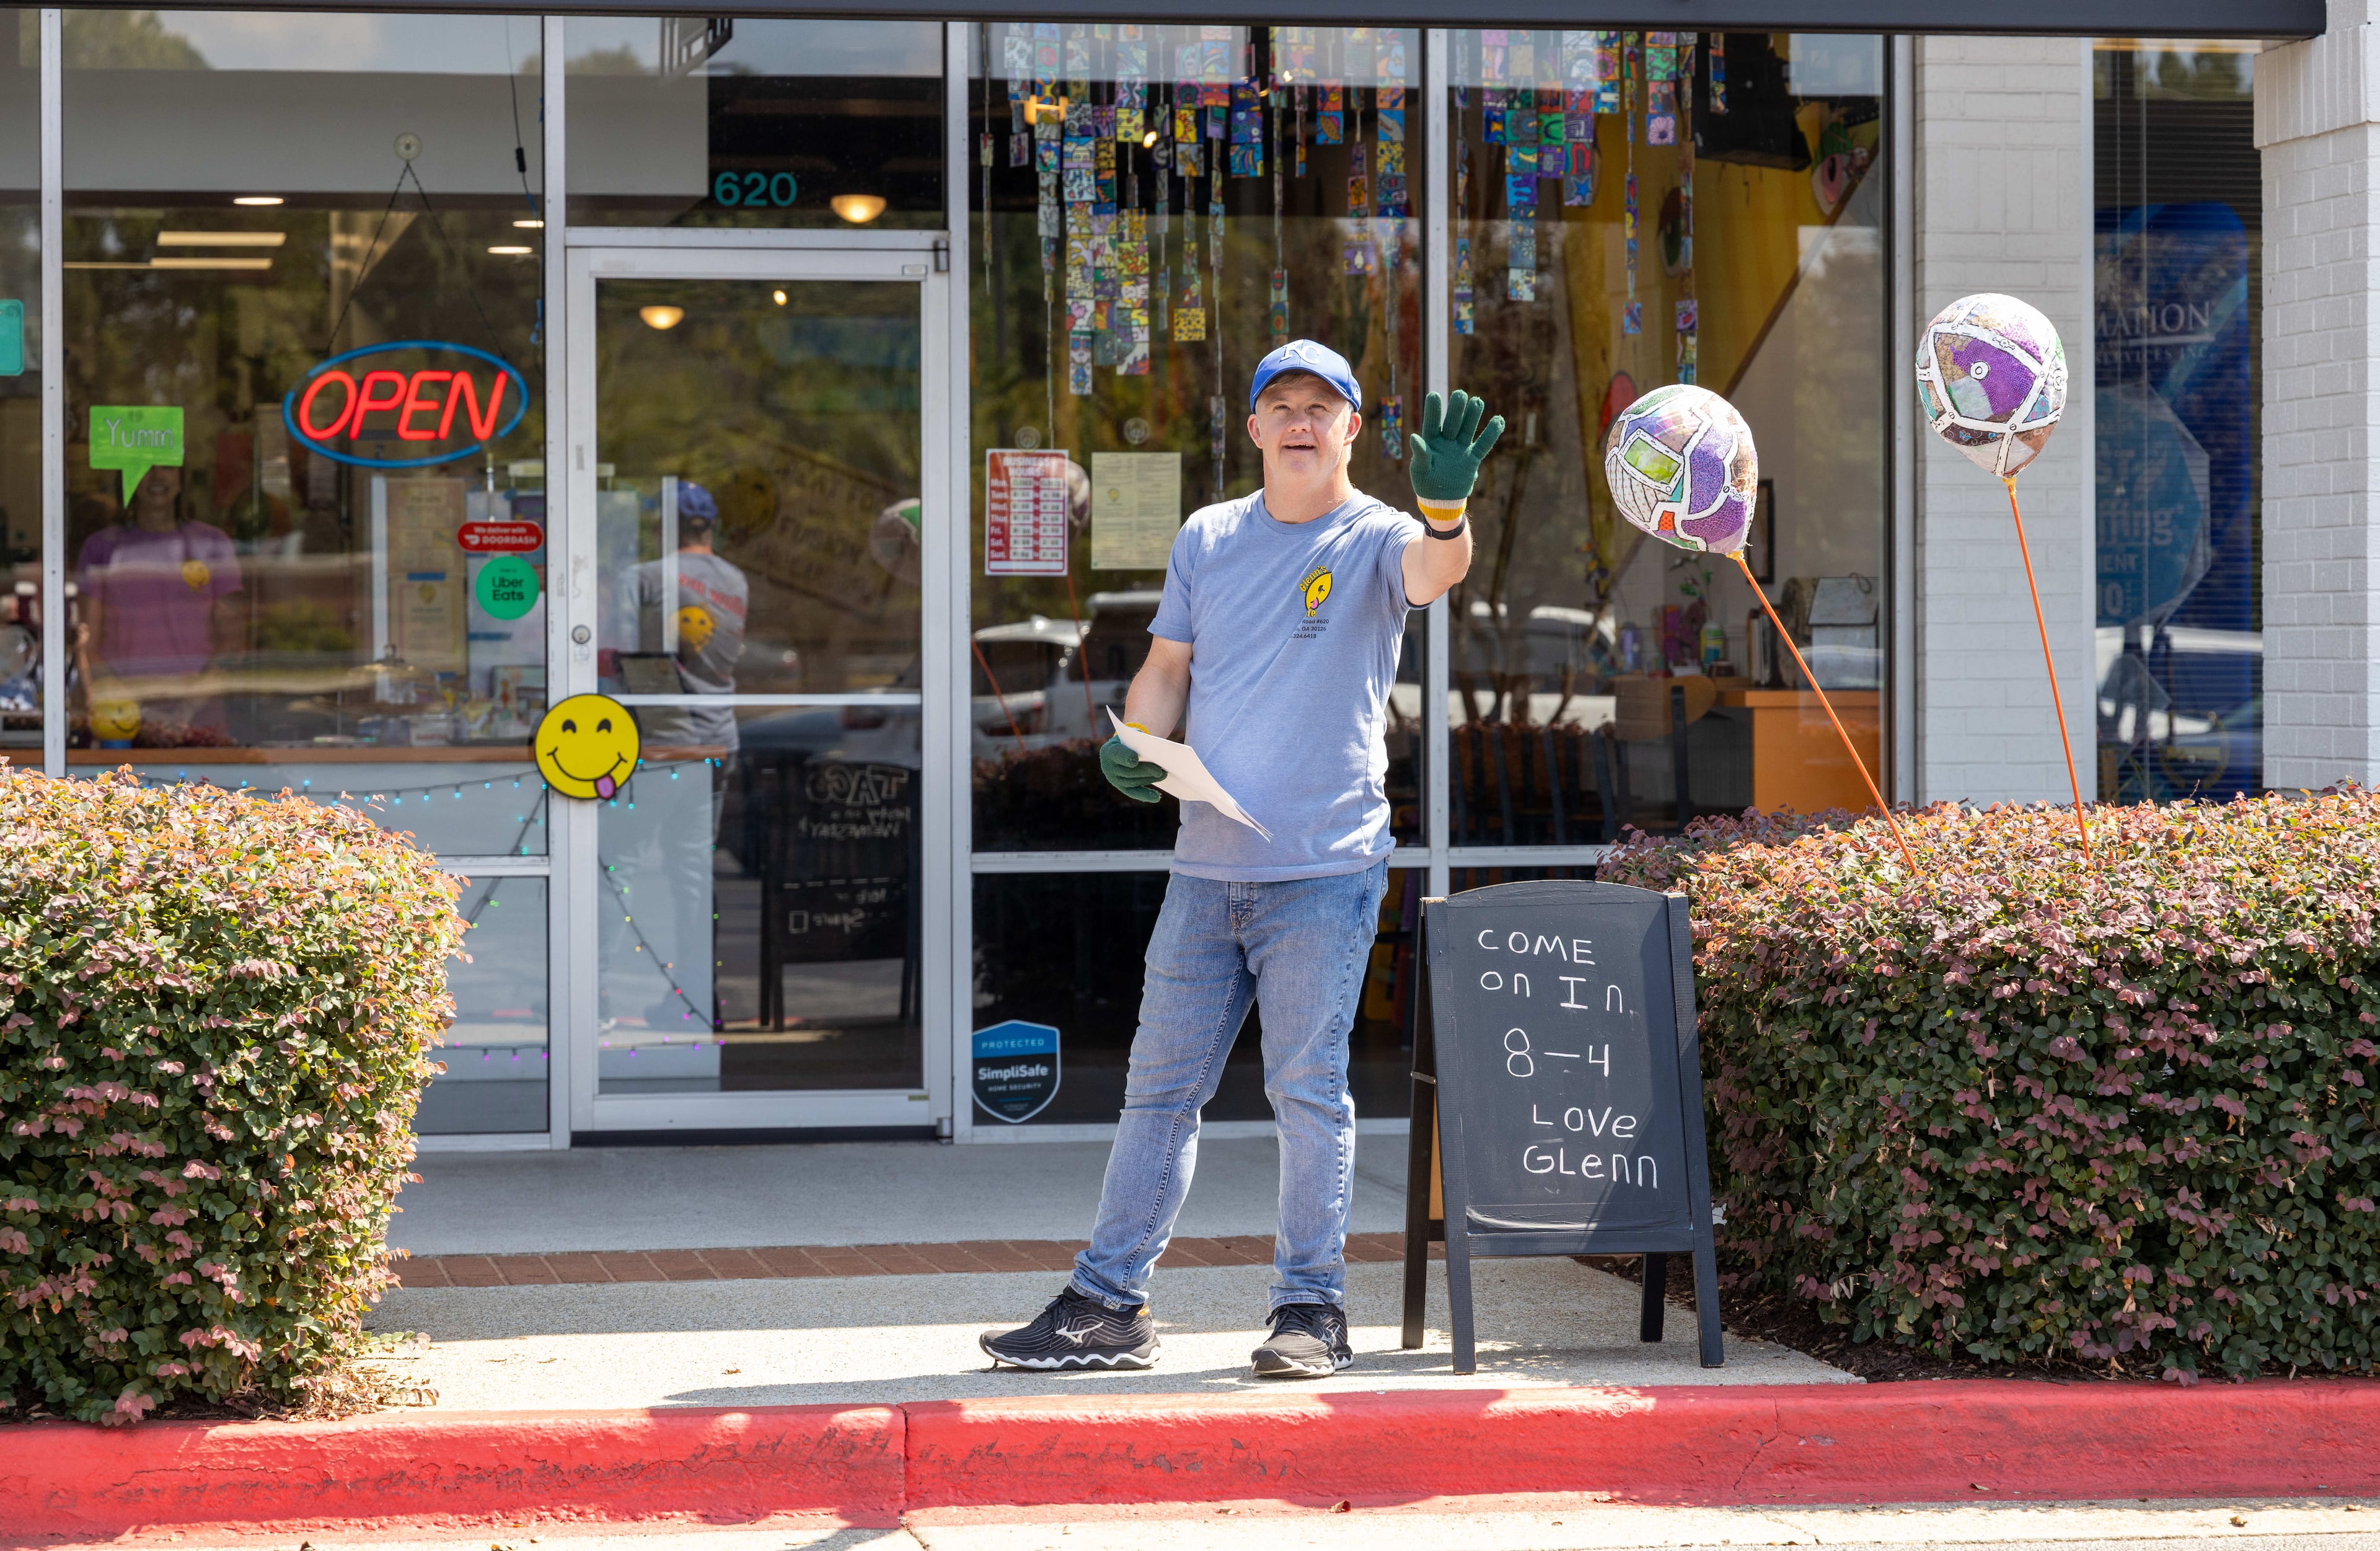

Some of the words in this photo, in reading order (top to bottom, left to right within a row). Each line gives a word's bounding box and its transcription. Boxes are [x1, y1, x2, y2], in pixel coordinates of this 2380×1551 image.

[715, 171, 798, 206] 620
[299, 370, 508, 441] OPEN
[104, 417, 174, 449] Yumm
[482, 535, 537, 545] DOORDASH
[491, 576, 524, 588] Uber
[1298, 565, 1328, 593] Glenn's
[492, 589, 525, 601] Eats
[1478, 929, 1597, 965] COME
[1480, 971, 1530, 998] on
[981, 1037, 1045, 1049] PROTECTED
[977, 1063, 1049, 1081] SimpliSafe
[988, 1084, 1007, 1092] HOME
[1008, 1082, 1042, 1092] SECURITY
